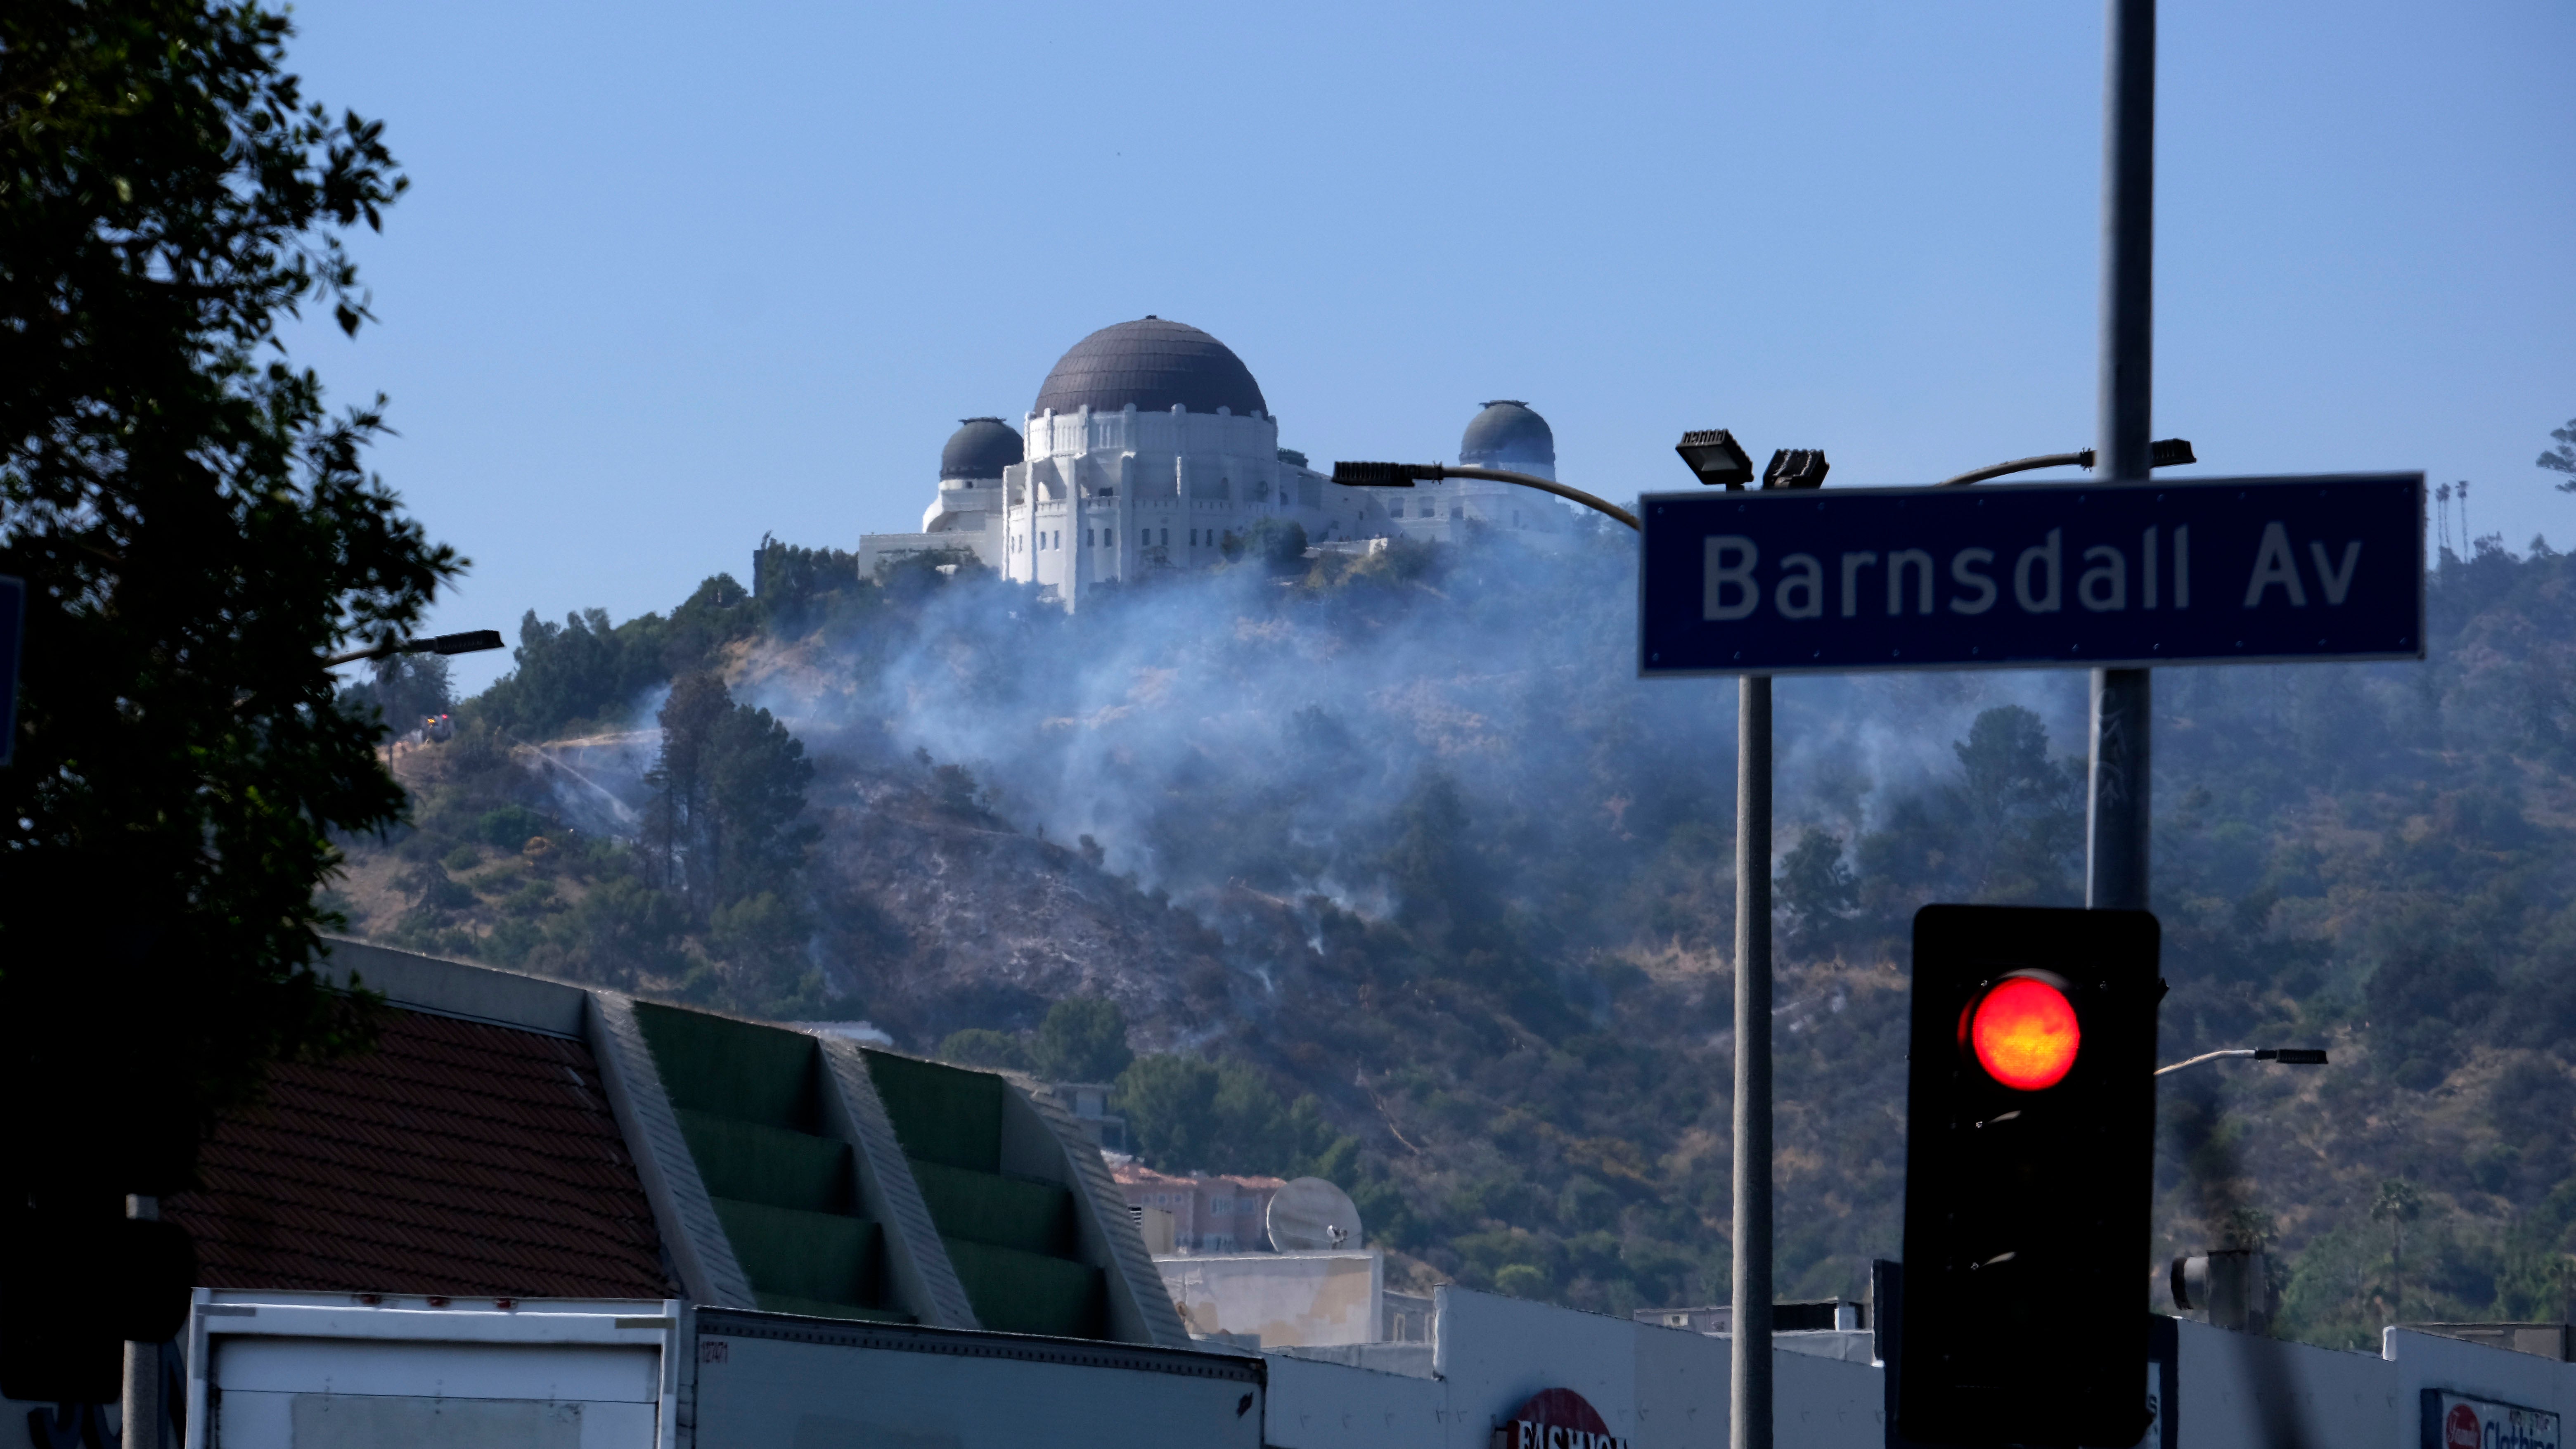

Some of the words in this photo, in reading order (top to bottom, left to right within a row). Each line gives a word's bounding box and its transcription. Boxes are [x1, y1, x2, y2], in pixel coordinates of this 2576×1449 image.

[1702, 522, 2190, 621] Barnsdall
[2243, 521, 2363, 609] Av
[2484, 1419, 2555, 1449] Clthi
